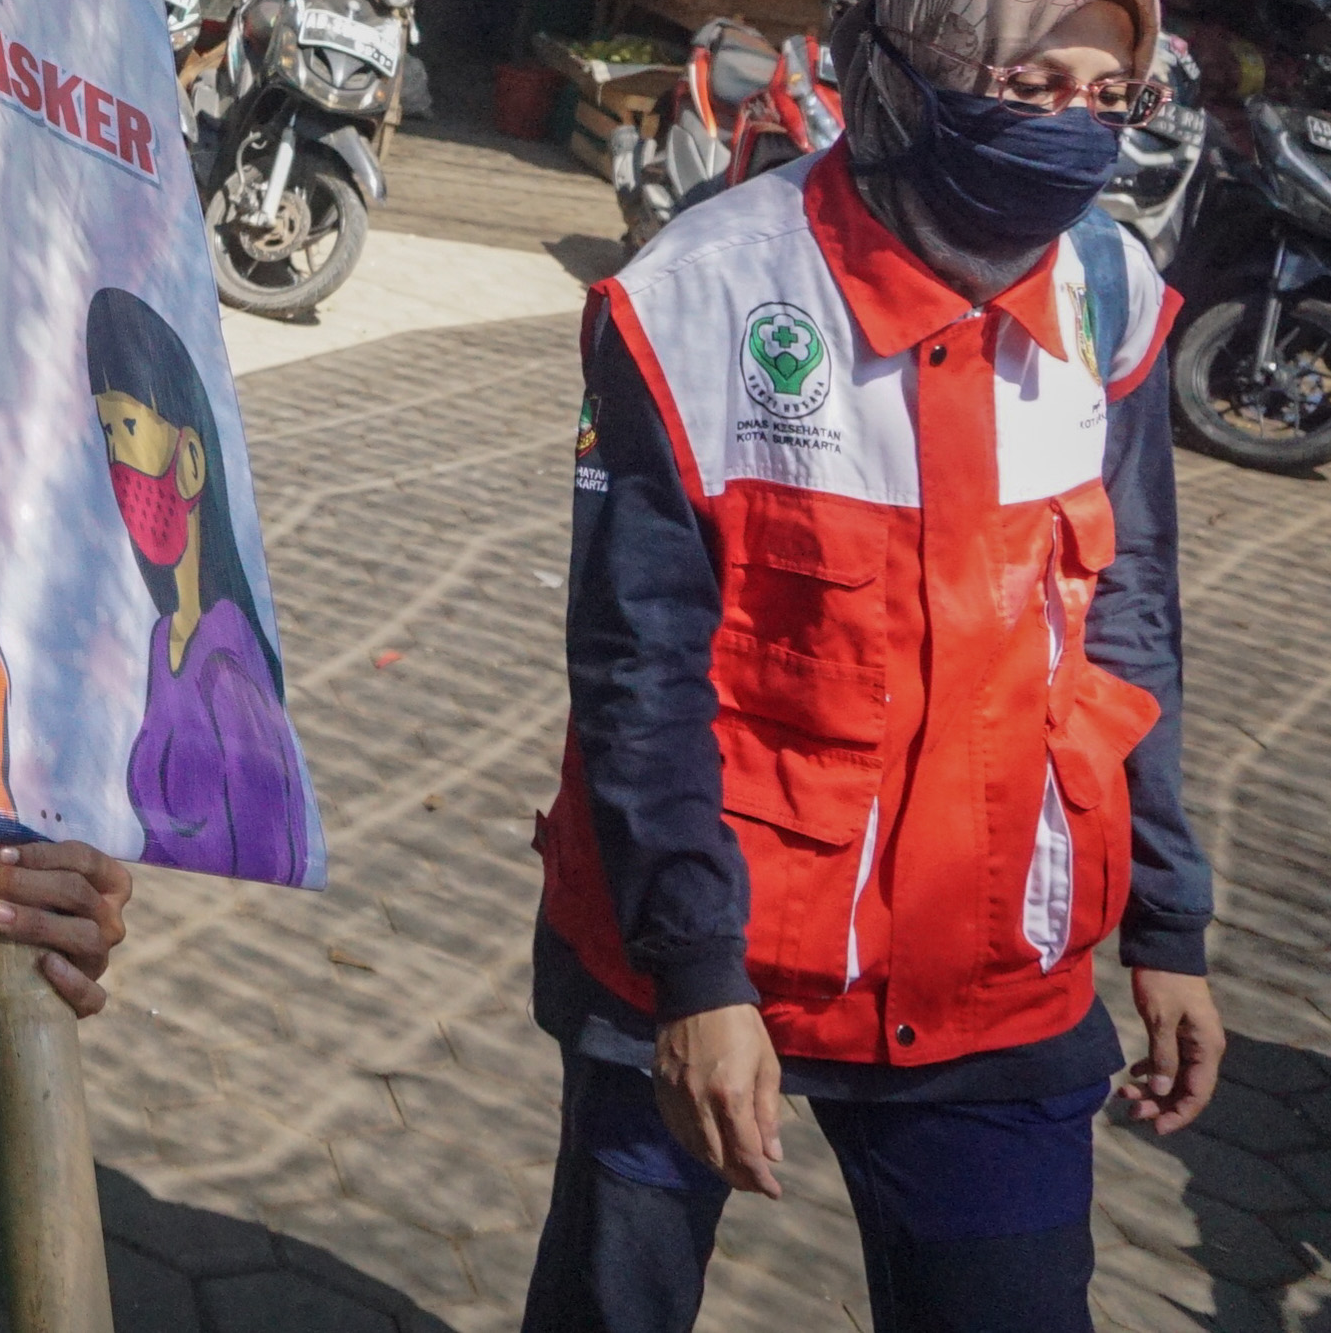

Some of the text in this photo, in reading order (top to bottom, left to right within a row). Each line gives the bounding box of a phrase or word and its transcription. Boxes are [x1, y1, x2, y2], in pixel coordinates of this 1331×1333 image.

[772, 422, 841, 441] KESEHATAN
[737, 431, 842, 454] KOTA SURAKARTA
